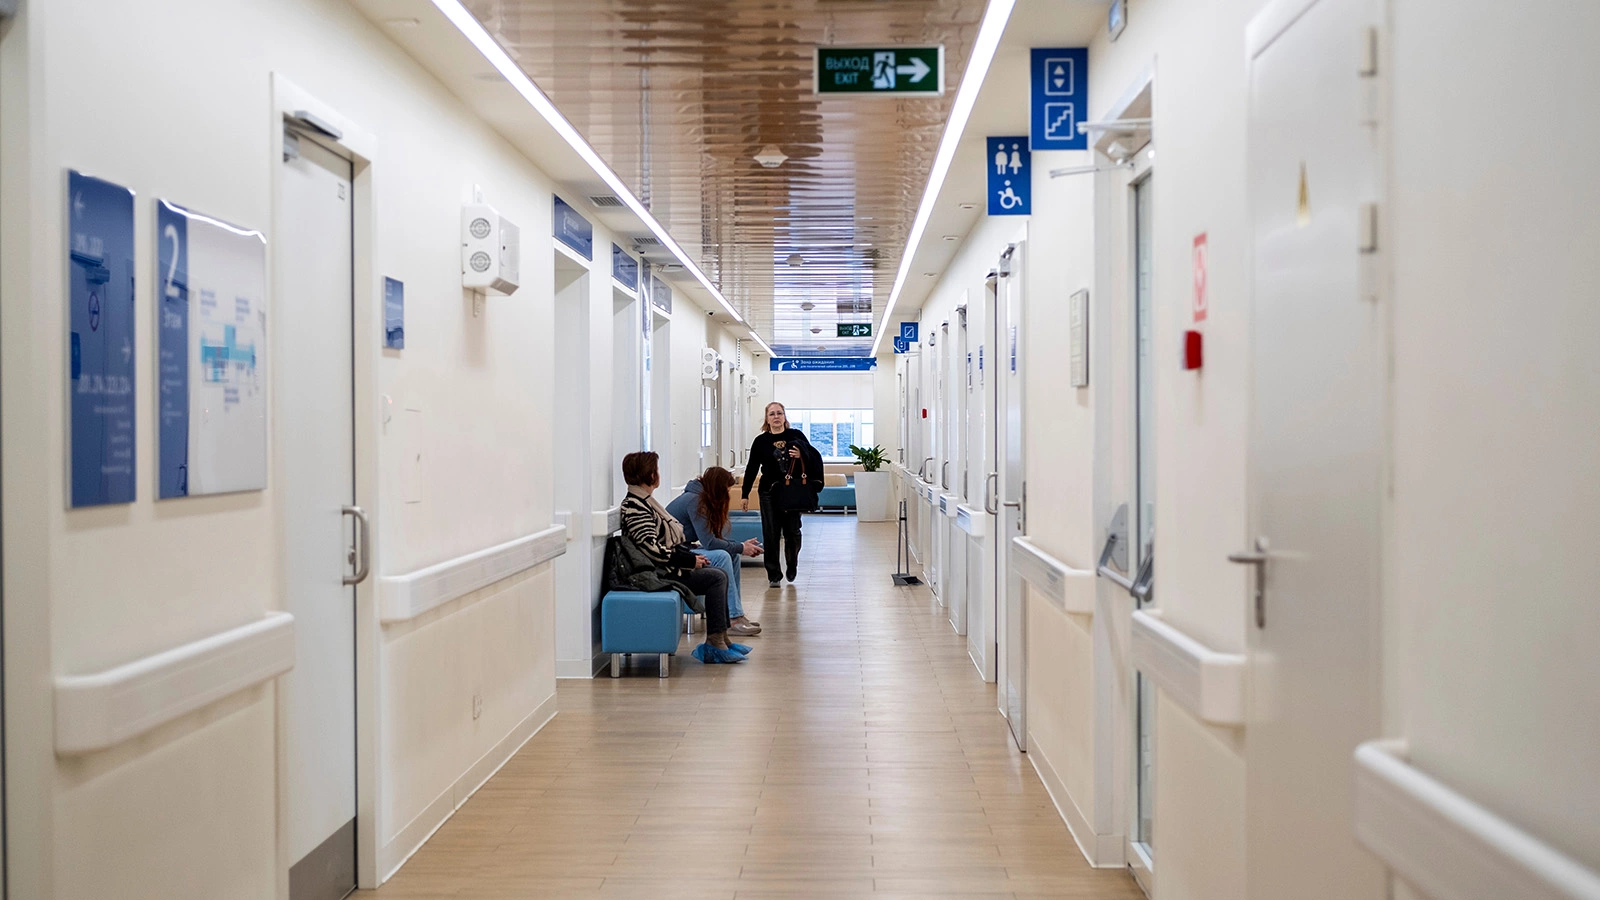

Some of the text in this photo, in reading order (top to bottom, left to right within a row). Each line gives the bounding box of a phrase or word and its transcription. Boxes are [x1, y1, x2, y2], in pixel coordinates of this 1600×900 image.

[825, 56, 870, 71] ВЫХОД
[834, 71, 859, 84] EXIT
[164, 223, 180, 298] 2
